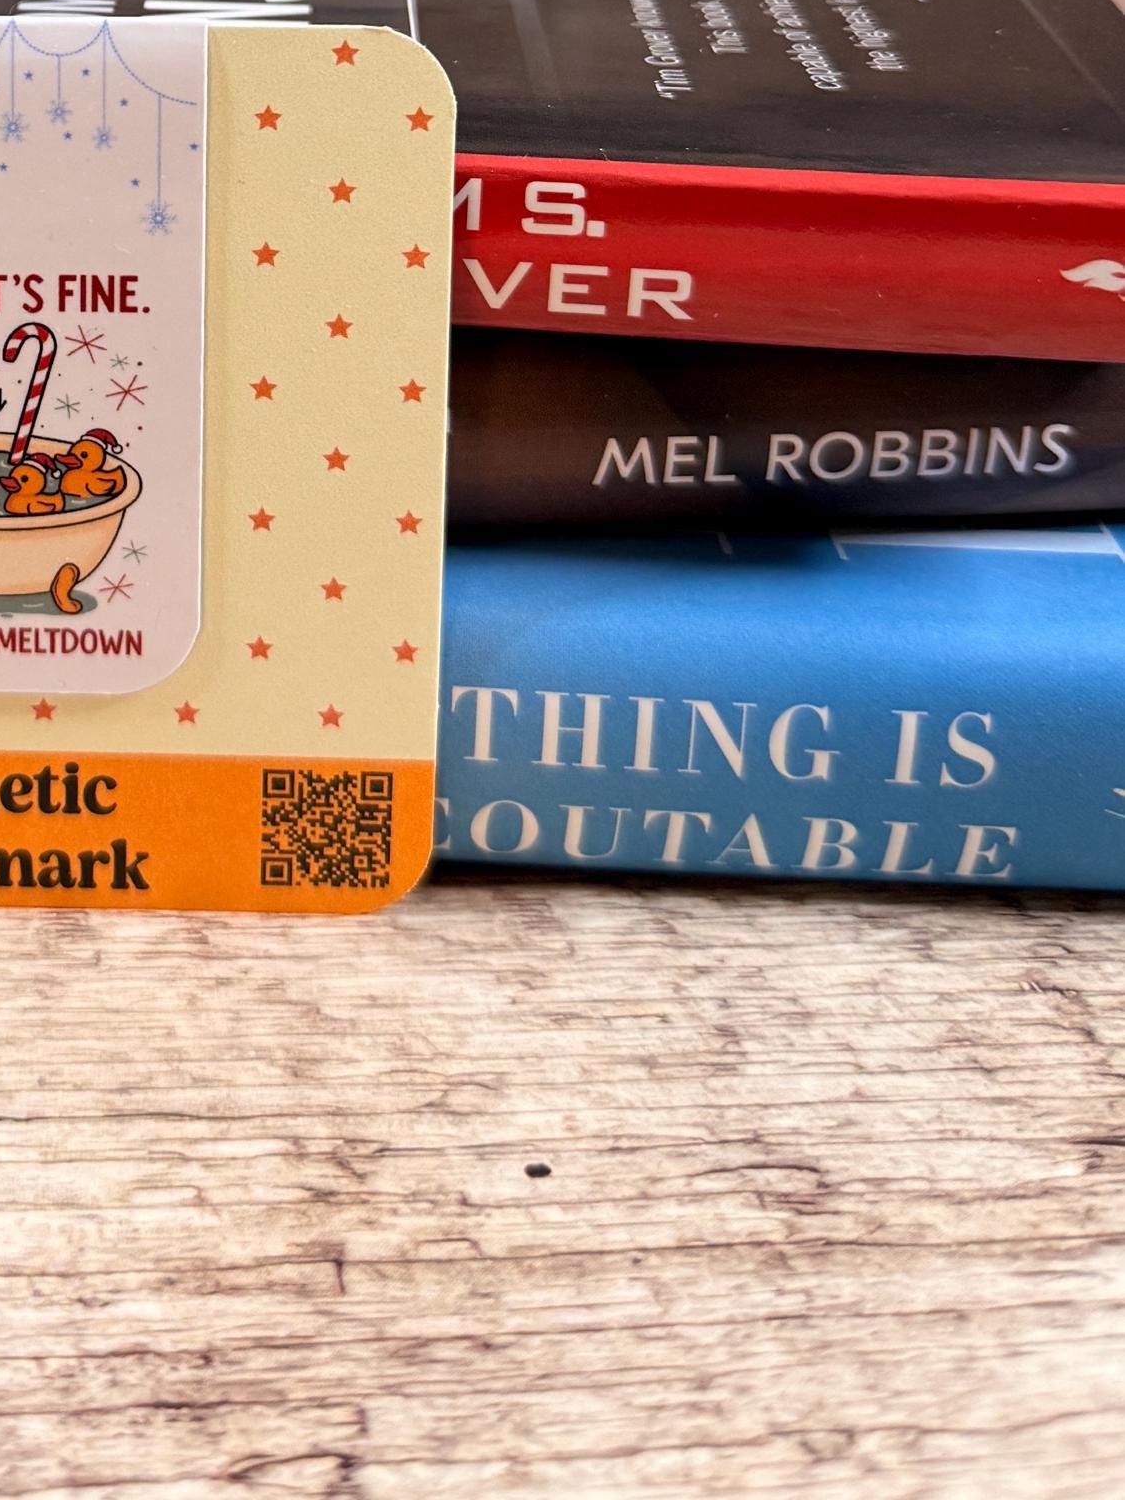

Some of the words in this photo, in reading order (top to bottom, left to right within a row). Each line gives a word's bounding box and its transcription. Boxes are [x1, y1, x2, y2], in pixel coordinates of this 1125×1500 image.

[784, 42, 849, 91] capable
[865, 50, 909, 72] the
[521, 180, 606, 238] S.
[58, 274, 151, 314] FINE.
[591, 436, 738, 486] MEL
[765, 423, 1075, 482] ROBBINS
[450, 685, 841, 782] THING
[883, 709, 997, 789] IS
